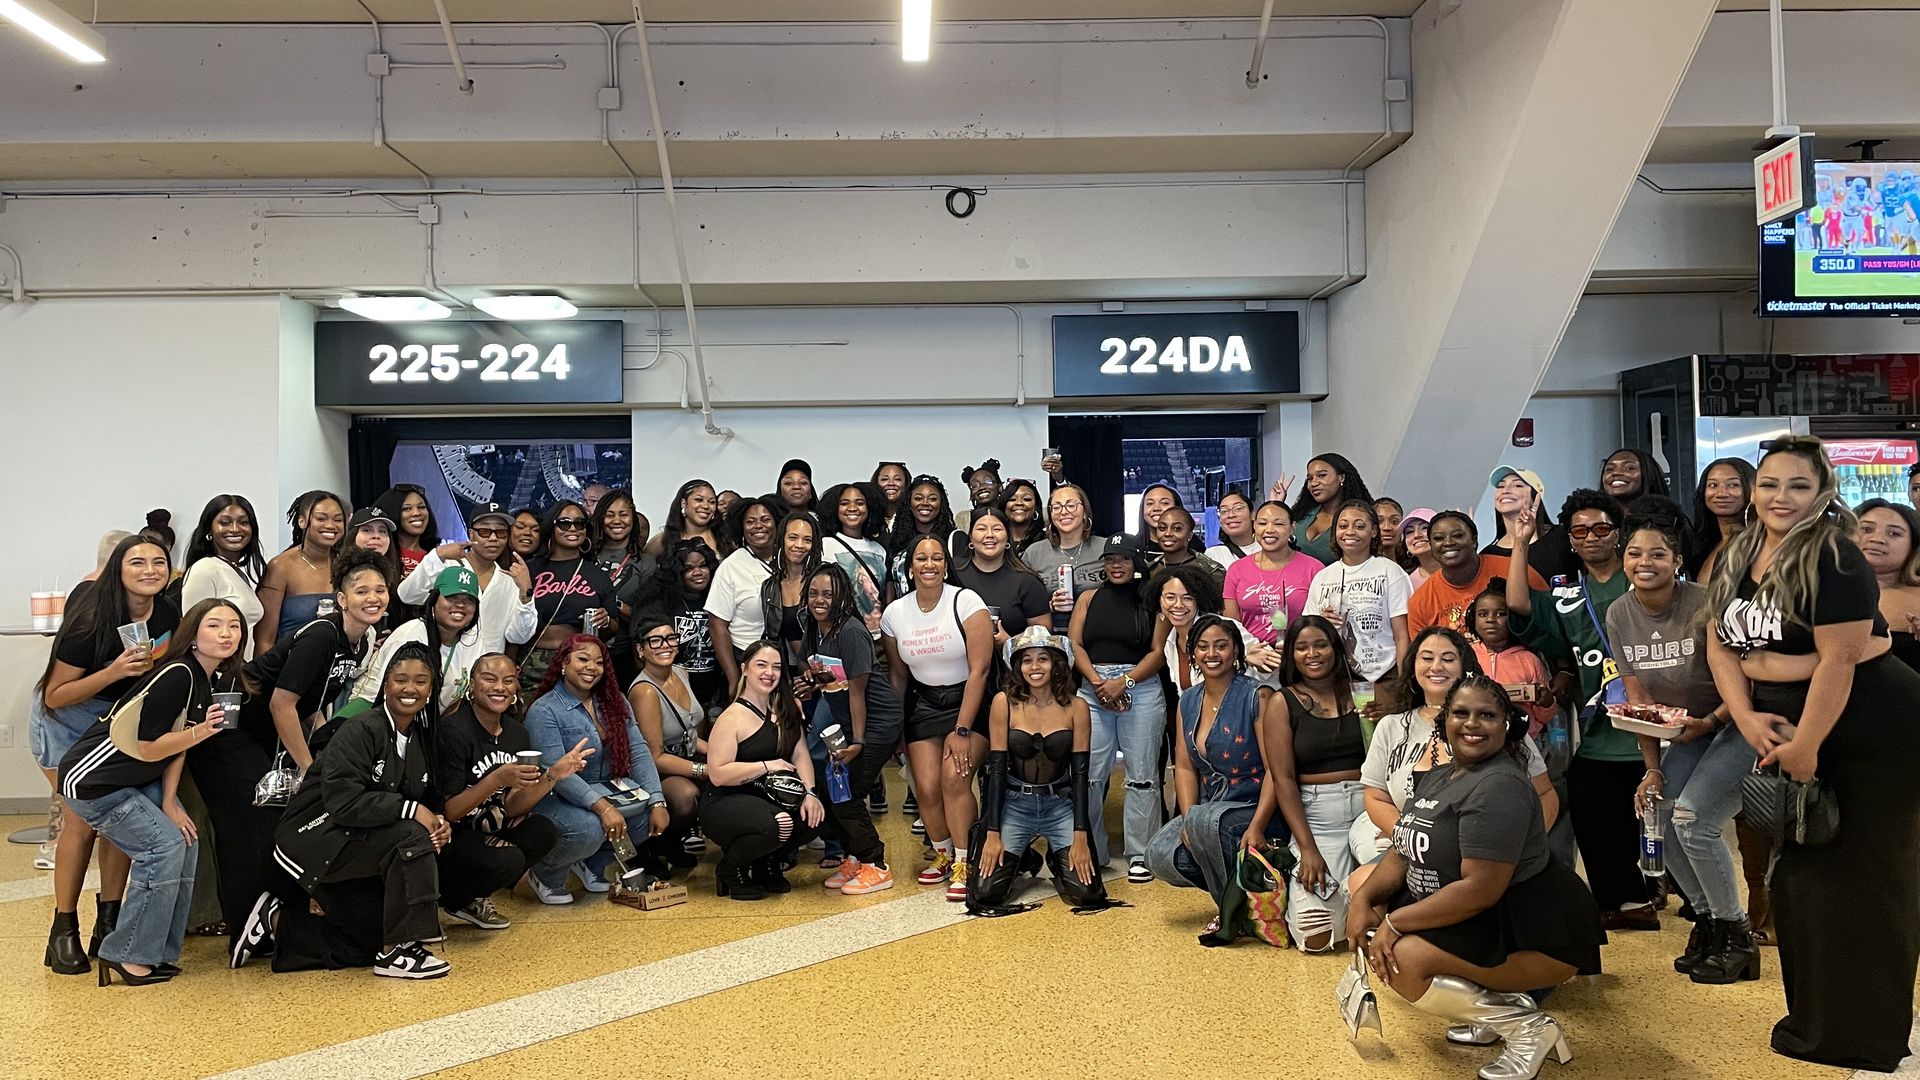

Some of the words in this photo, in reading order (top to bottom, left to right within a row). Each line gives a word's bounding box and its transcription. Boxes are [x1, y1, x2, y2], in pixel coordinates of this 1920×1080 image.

[1762, 151, 1794, 212] EXIT
[1819, 258, 1856, 271] 350.0
[1766, 300, 1827, 311] ticketmaster
[1829, 302, 1843, 310] The
[1844, 302, 1870, 310] Official
[1871, 302, 1892, 310] Ticket
[1100, 335, 1252, 374] 224DA
[368, 343, 571, 382] 225-224
[1828, 446, 1878, 457] Budweiser
[490, 503, 499, 512] P
[533, 571, 596, 599] Barbie
[915, 626, 938, 636] SUPPORT
[930, 633, 952, 644] RIGHTS
[917, 645, 945, 655] WRONGS
[1622, 638, 1695, 662] SPURS
[667, 892, 687, 900] CHICKEN
